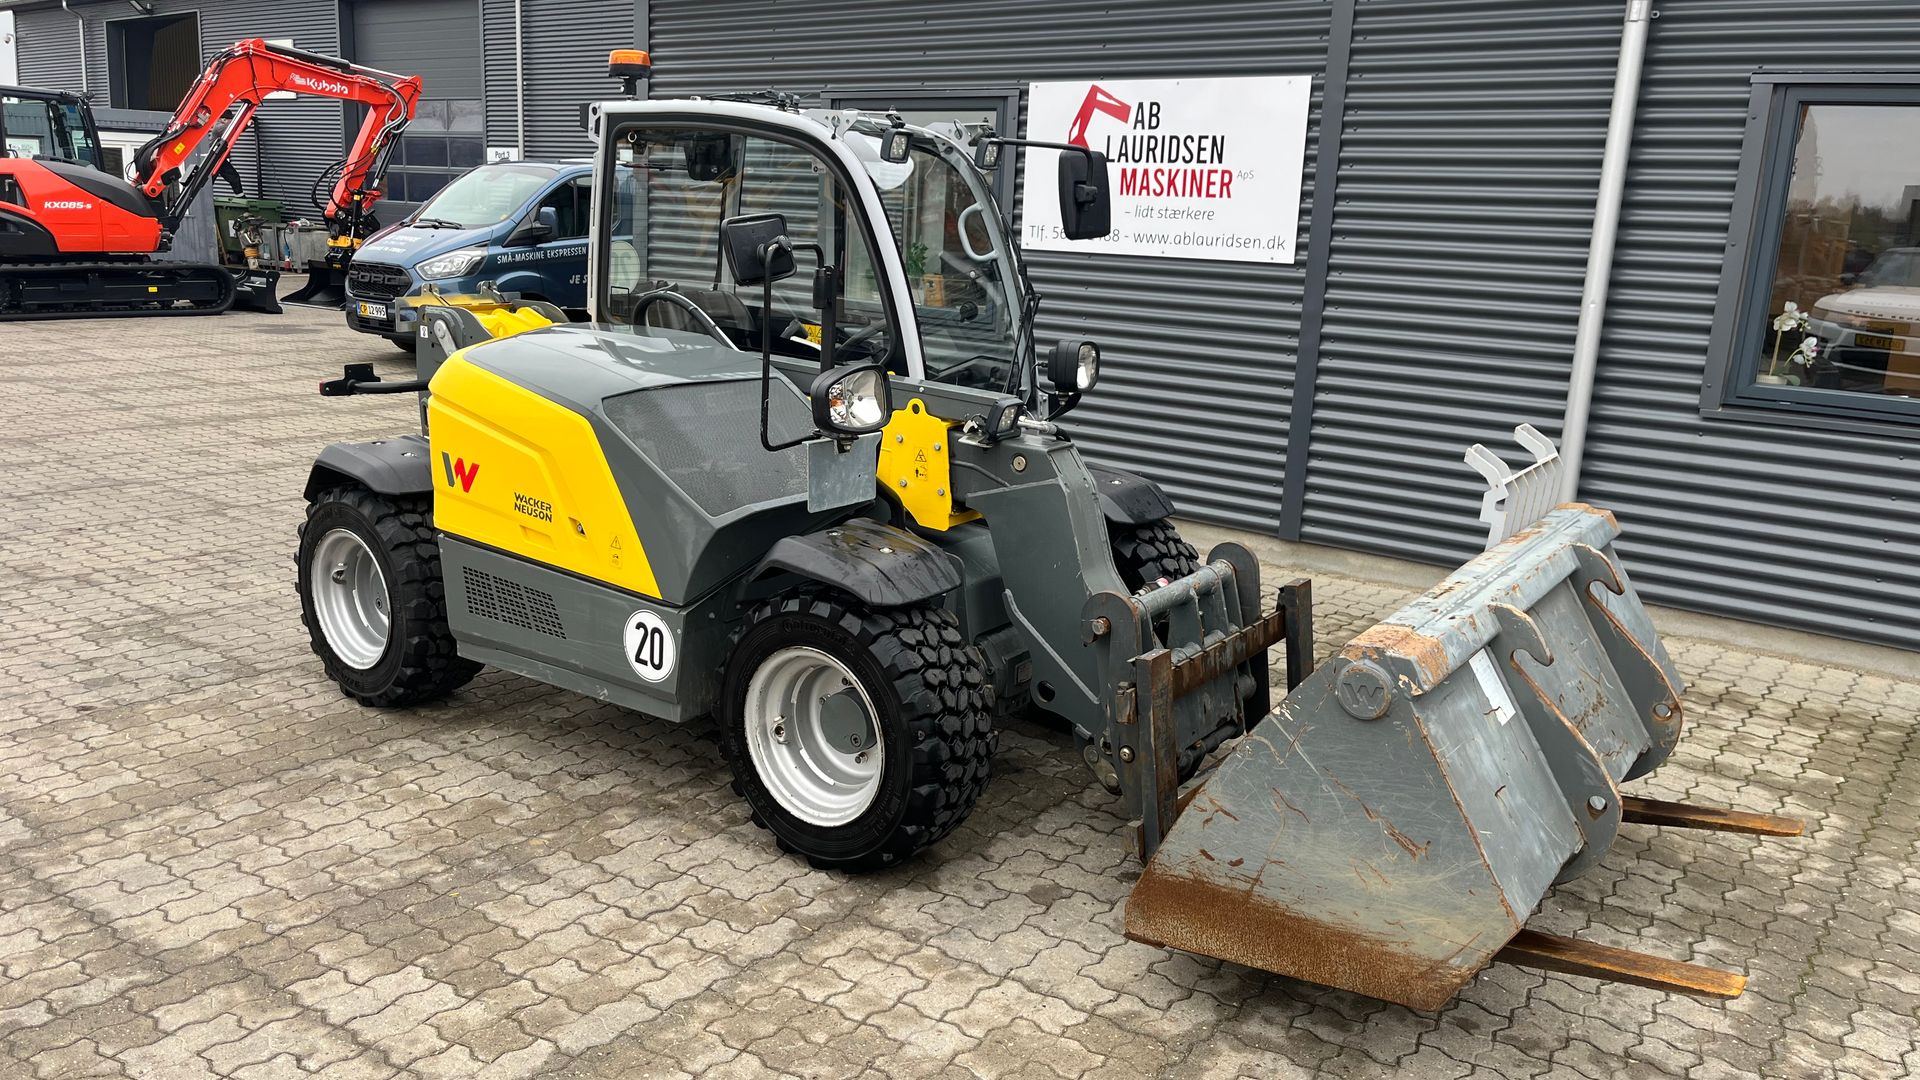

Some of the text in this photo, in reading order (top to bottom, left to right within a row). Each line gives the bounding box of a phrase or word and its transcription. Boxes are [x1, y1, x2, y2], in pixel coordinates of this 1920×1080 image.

[307, 78, 349, 95] Kubota
[1133, 101, 1161, 130] AB
[1106, 135, 1225, 164] LAURIDSEN
[1120, 168, 1255, 198] MASKINER ApS
[1134, 205, 1154, 218] lidt
[1157, 206, 1215, 221] stærkere
[1029, 225, 1048, 242] Tlf.
[1133, 231, 1286, 250] www.ablauridsen.dk
[497, 246, 587, 264] SMÅ-MASKINE EKSPRESSEN
[514, 492, 552, 513] WACKER
[514, 502, 552, 523] NEUSON
[635, 621, 664, 671] 20
